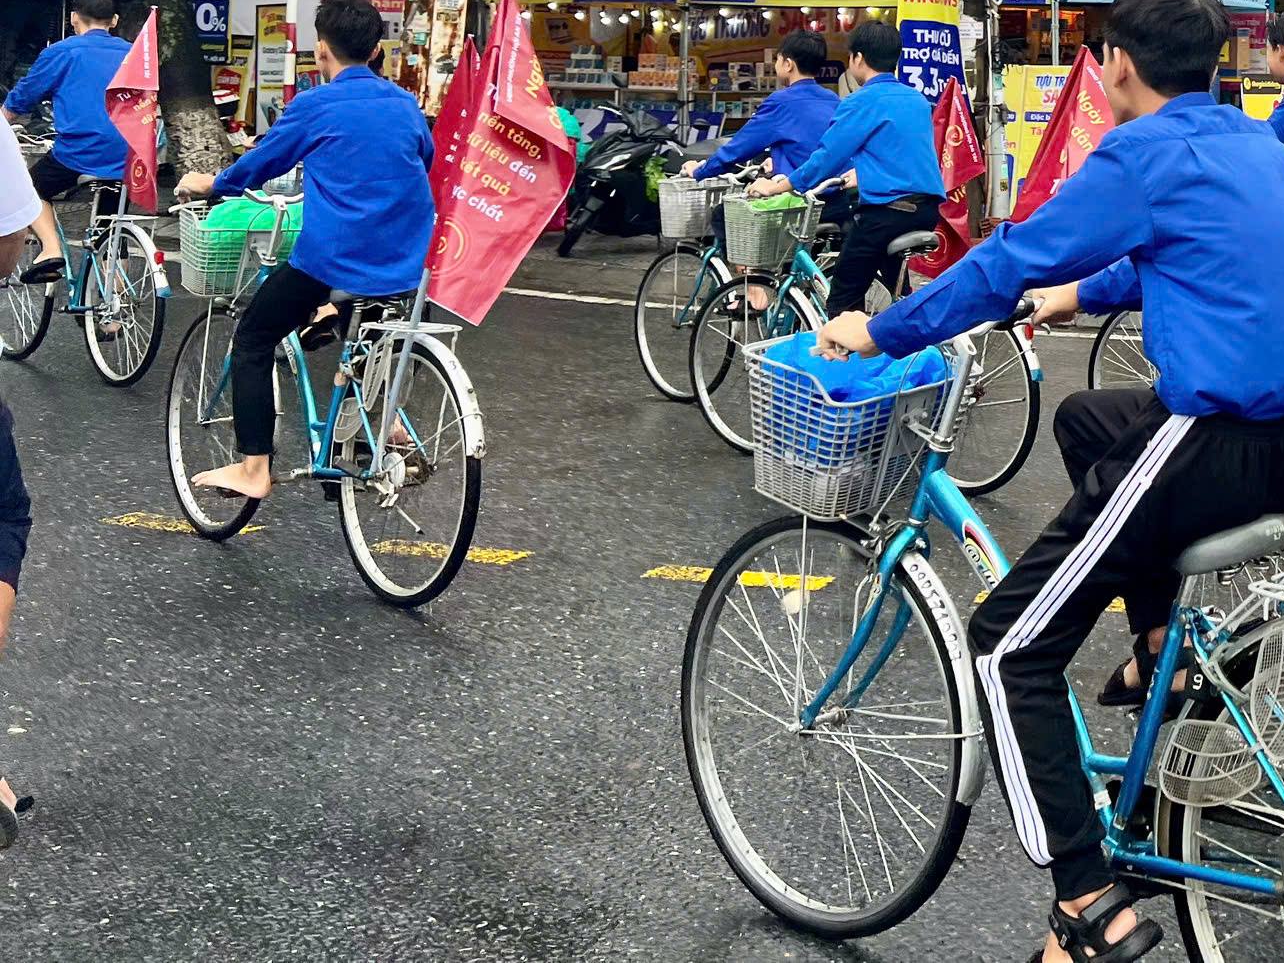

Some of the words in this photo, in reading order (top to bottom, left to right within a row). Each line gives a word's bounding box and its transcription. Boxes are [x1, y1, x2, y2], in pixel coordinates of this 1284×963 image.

[902, 47, 931, 63] TRỢ
[1076, 90, 1105, 126] Ngày
[478, 111, 506, 135] nền
[506, 127, 542, 160] tảng,
[481, 140, 509, 166] liệu
[508, 158, 537, 184] đến
[481, 172, 512, 198] quả
[467, 191, 505, 223] chất
